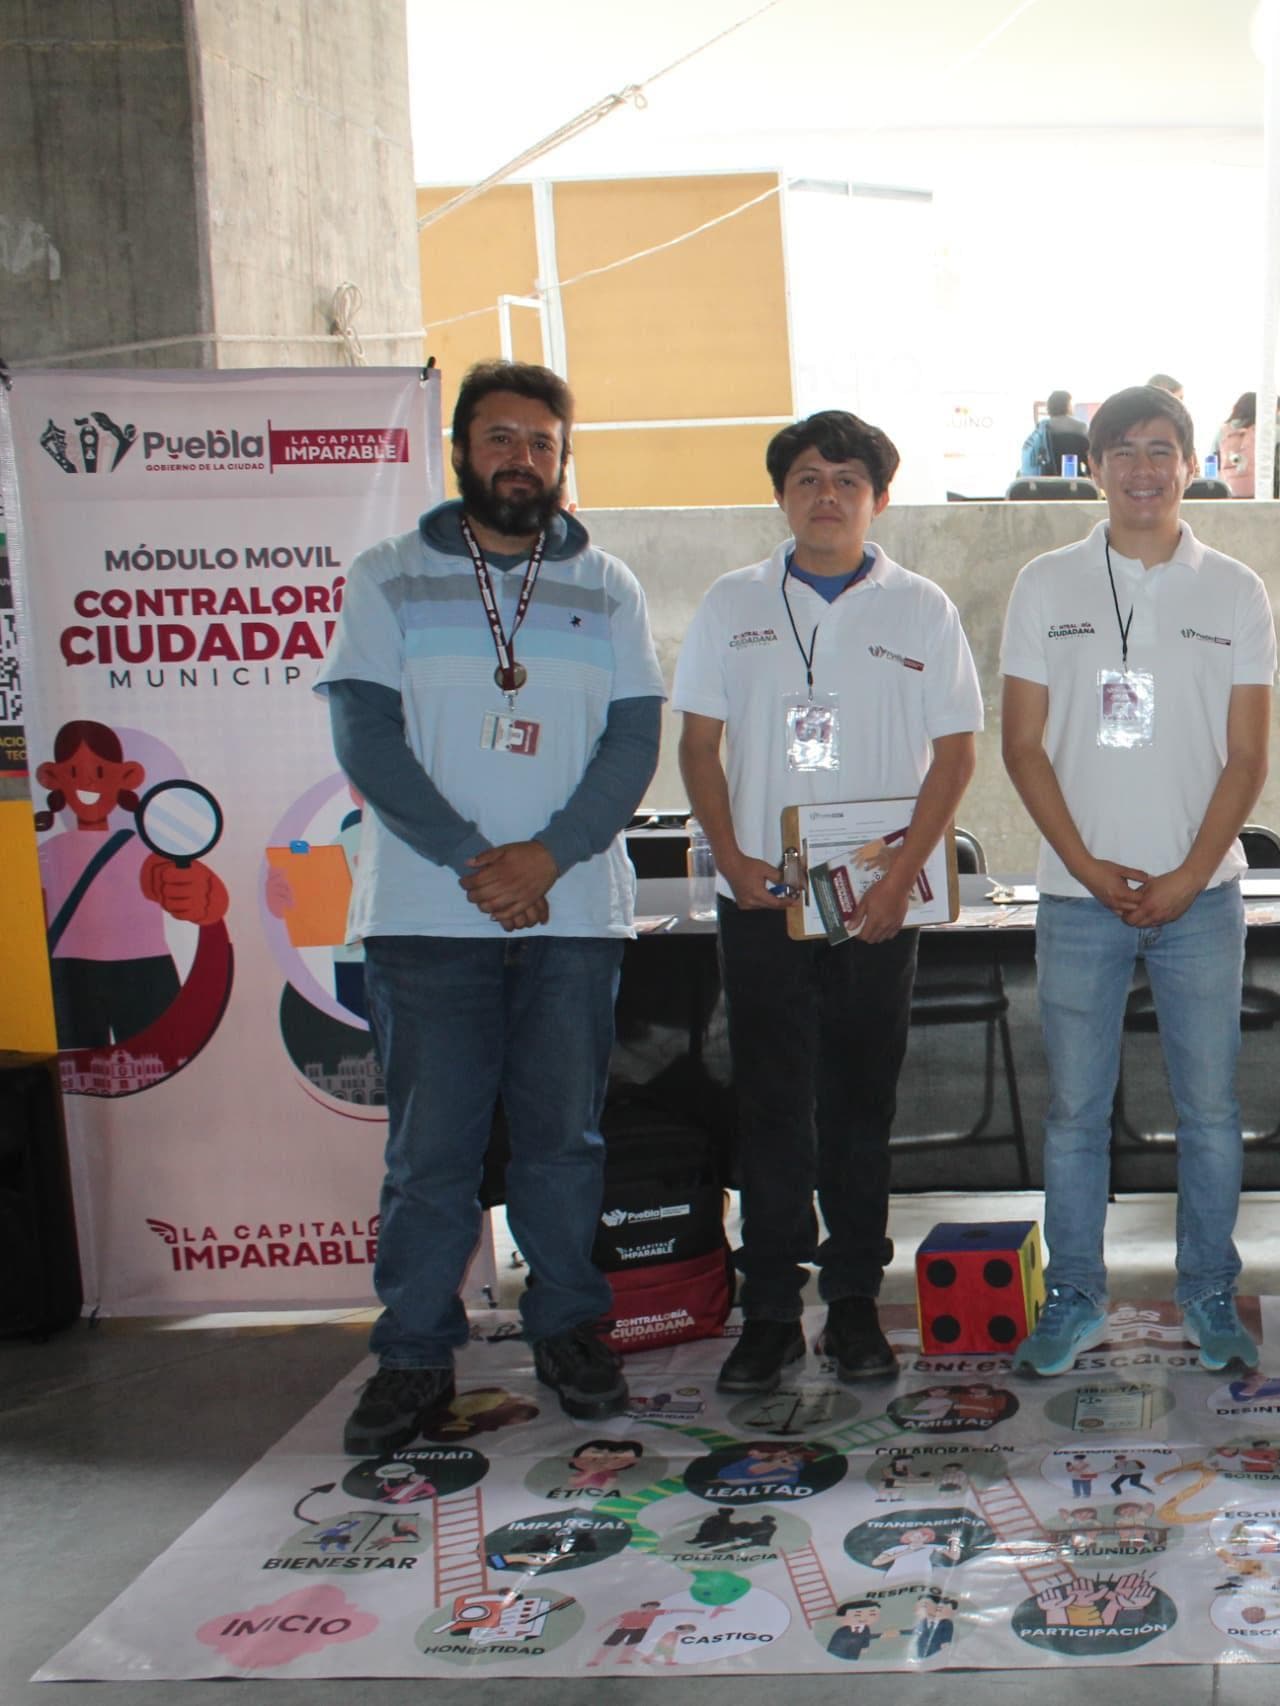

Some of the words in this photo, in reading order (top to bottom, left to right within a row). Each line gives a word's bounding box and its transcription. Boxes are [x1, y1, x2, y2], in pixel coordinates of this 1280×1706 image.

[143, 428, 264, 460] Puebla
[291, 435, 310, 446] LA
[317, 434, 387, 445] CAPITAL
[284, 444, 397, 461] IMPARABLE
[146, 463, 197, 472] GOBIERNO
[199, 463, 211, 471] DE
[213, 463, 225, 471] LA
[227, 462, 265, 471] CIUDAD
[105, 543, 239, 572] MÓDULO
[245, 545, 341, 569] MOVIL
[73, 575, 347, 619] CONTRALORÍ
[59, 620, 338, 668] CIUDADA
[108, 665, 302, 690] MUNICIP
[183, 1226, 218, 1242] LA
[233, 1220, 366, 1240] CAPITAL
[621, 1246, 673, 1260] IMPARABLE
[616, 1308, 688, 1328] CONTRALORÍA
[610, 1316, 695, 1339] CIUDADANA
[903, 1417, 994, 1430] AMISTAD
[392, 1450, 474, 1462] VERDAD
[546, 1486, 622, 1500] ÉTICA
[704, 1484, 813, 1498] LEALTAD
[866, 1516, 987, 1529] TRANSPARENCIA
[262, 1556, 418, 1571] BIENESTAR
[672, 1552, 779, 1563] TOLERANCIA
[865, 1585, 943, 1599] RESPETO
[220, 1614, 352, 1637] INICIO
[1019, 1622, 1168, 1637] PARTICIPACIÓN
[680, 1631, 774, 1645] CASTIGO
[423, 1644, 545, 1656] HONESTIDAD
